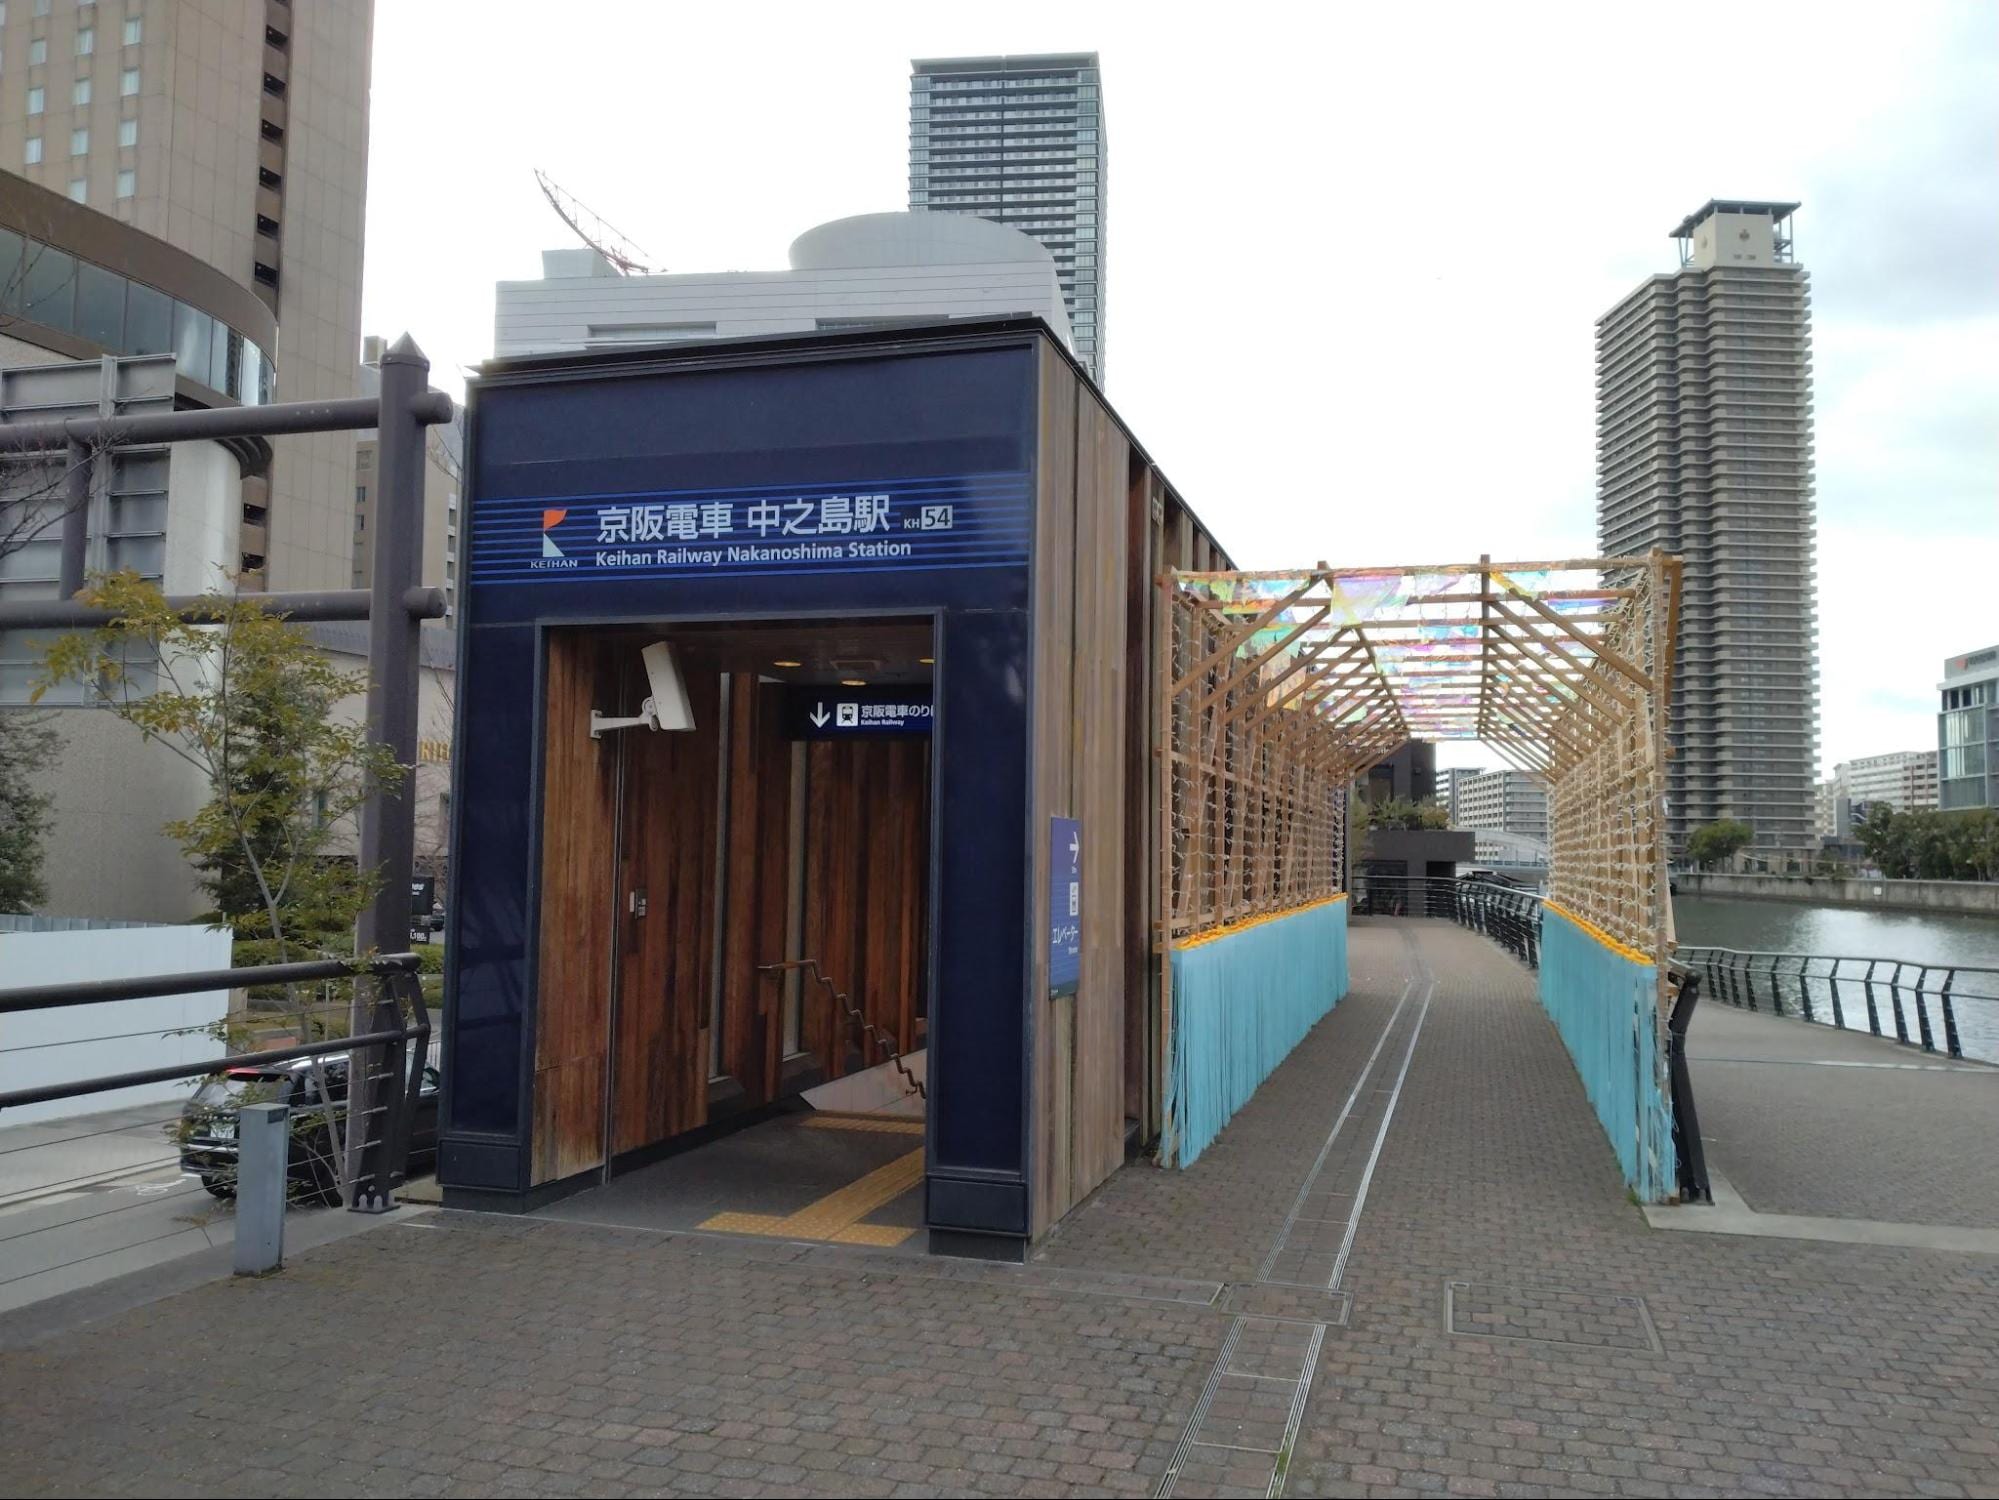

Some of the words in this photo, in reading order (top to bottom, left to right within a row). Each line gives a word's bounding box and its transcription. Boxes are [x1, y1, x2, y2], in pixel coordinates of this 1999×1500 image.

[596, 501, 734, 544] 京阪電車
[747, 494, 890, 538] 中之島駅
[596, 551, 651, 566] Keihan
[657, 547, 722, 567] Railway
[727, 543, 843, 562] Nakanoshima
[848, 540, 911, 558] Station
[530, 559, 578, 569] KEIHAN
[881, 718, 905, 727] Railway
[1052, 925, 1079, 945] エレベーター
